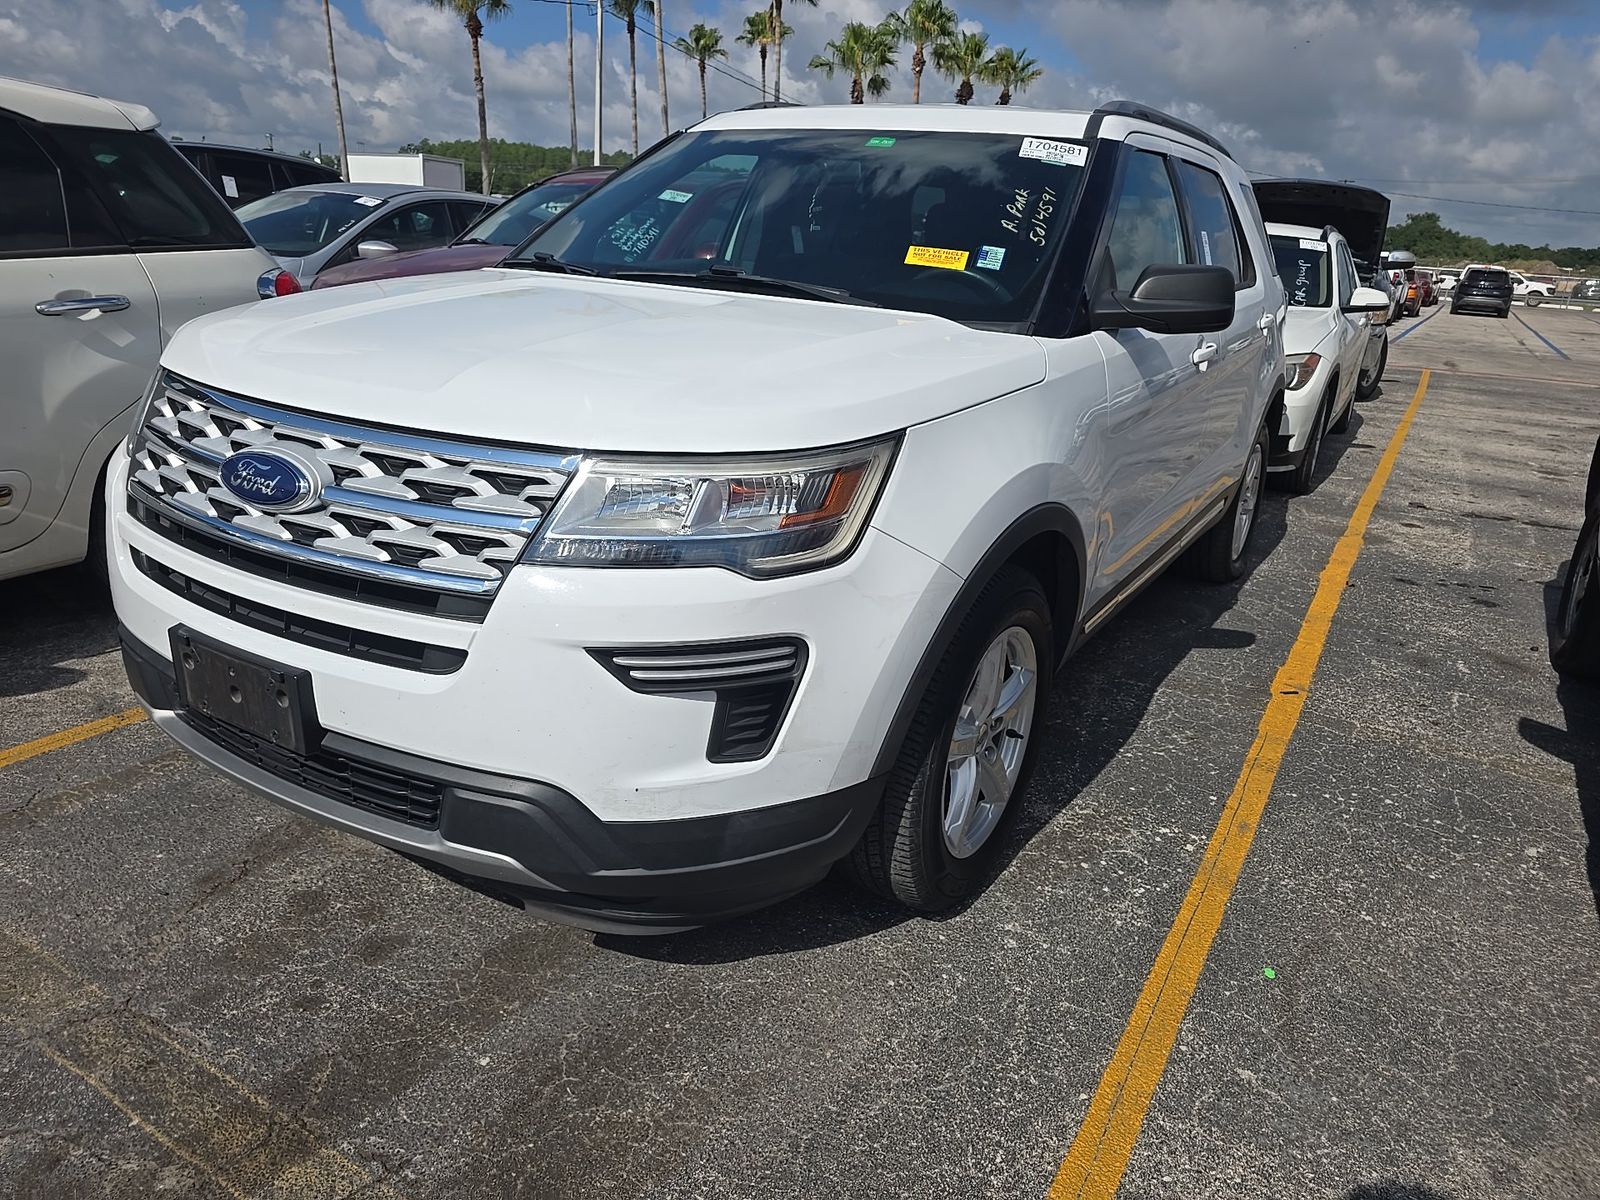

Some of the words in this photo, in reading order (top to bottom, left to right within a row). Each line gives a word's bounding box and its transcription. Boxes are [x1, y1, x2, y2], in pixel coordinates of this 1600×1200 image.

[1028, 140, 1082, 156] 1704581
[933, 249, 965, 258] VEHICLE
[231, 459, 281, 496] Ford
